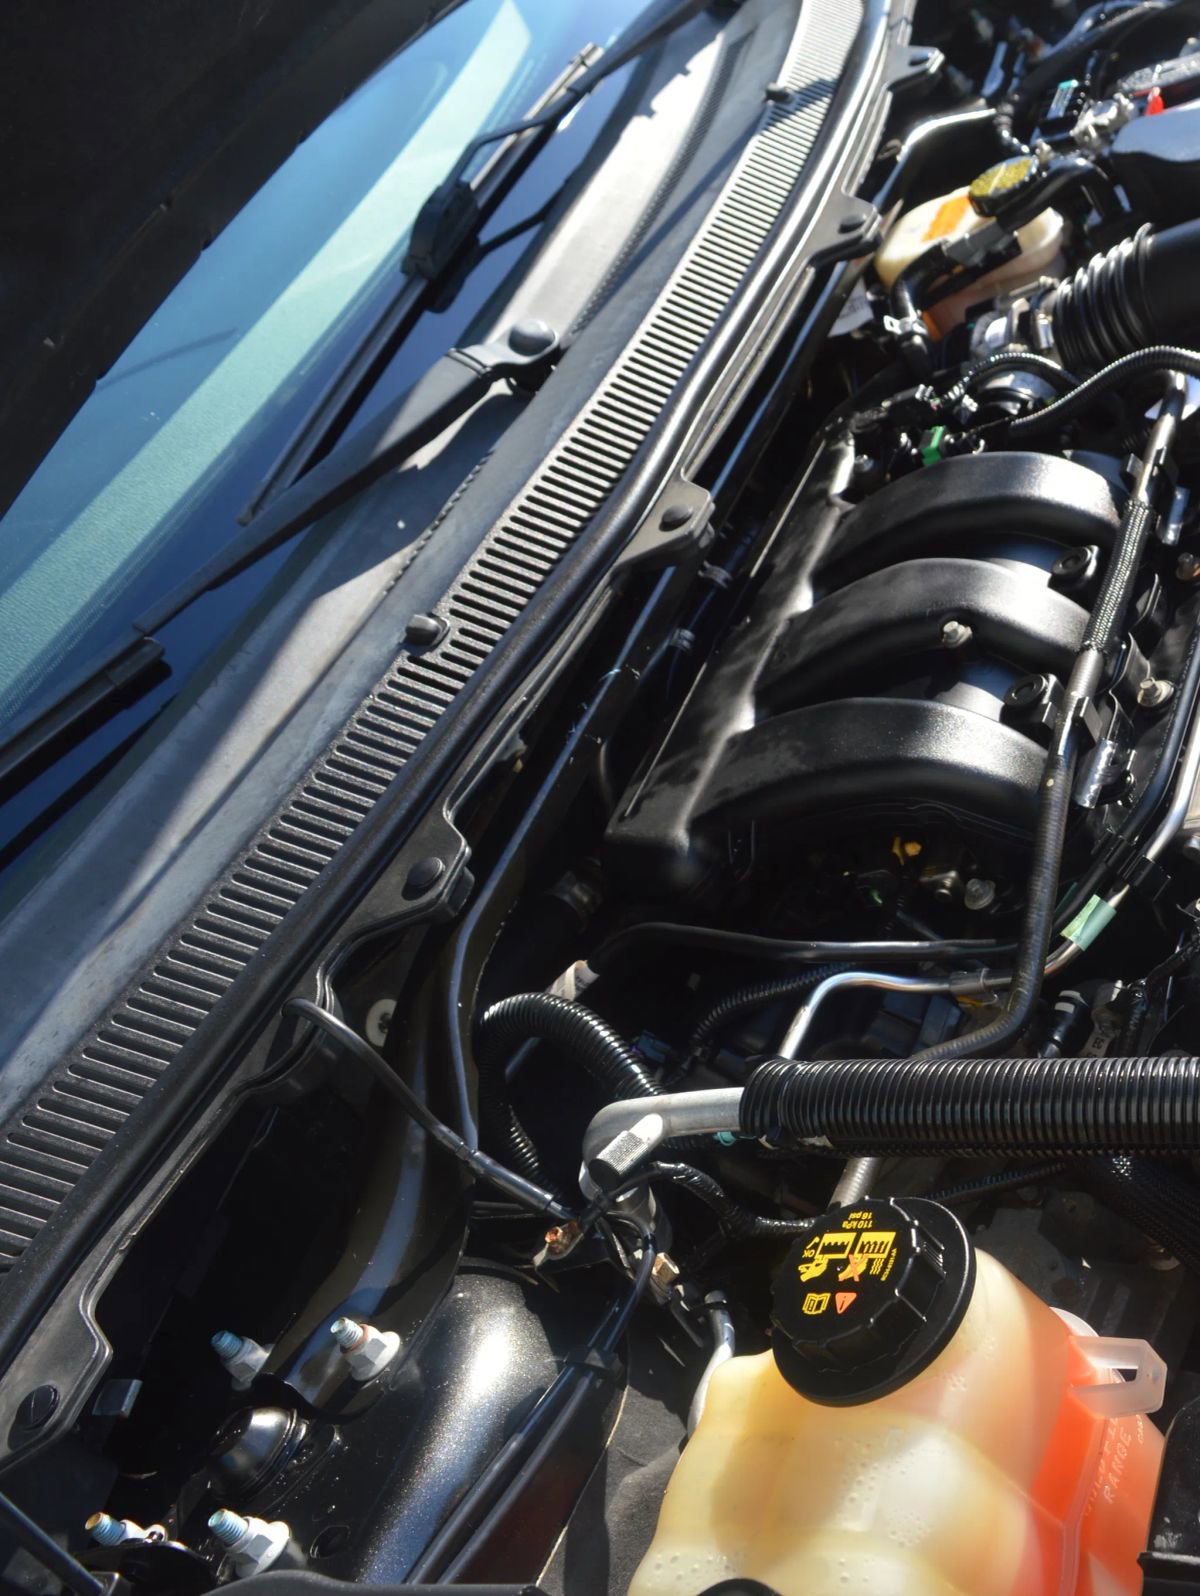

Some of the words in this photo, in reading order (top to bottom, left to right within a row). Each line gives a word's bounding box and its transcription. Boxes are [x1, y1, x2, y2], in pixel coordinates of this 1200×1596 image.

[849, 1211, 862, 1220] psi
[842, 1221, 857, 1229] kPa
[802, 1249, 815, 1258] OK
[1103, 1426, 1132, 1504] RANGE
